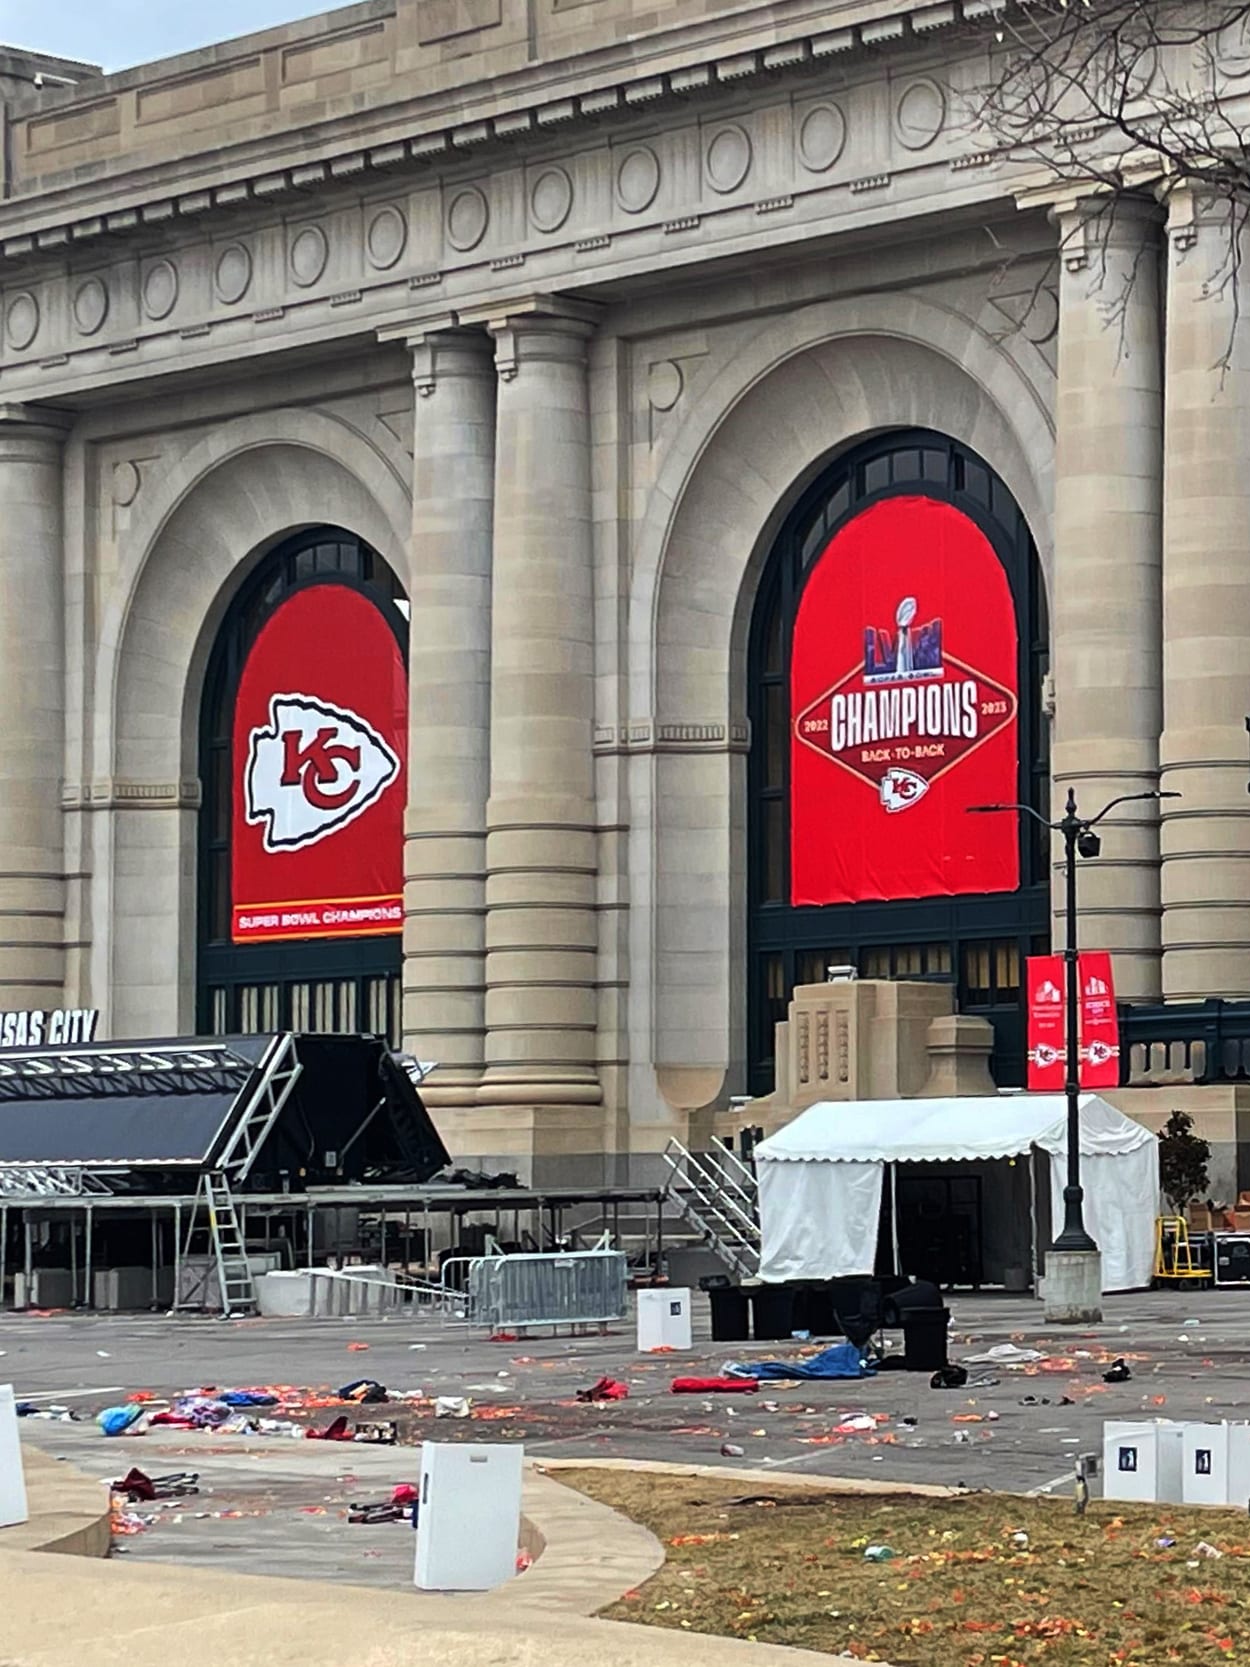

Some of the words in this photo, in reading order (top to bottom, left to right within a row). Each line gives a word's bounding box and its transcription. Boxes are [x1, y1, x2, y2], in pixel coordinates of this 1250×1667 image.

[831, 680, 978, 751] CHAMPIONS
[981, 701, 1007, 715] 2023
[804, 719, 829, 733] 2022
[281, 727, 361, 810] KC
[892, 777, 918, 799] KC
[239, 915, 279, 929] SUPER
[281, 912, 320, 926] BOWL
[322, 906, 402, 924] CHAMPIONS
[0, 1009, 45, 1048] SAS
[48, 1008, 97, 1046] CITY
